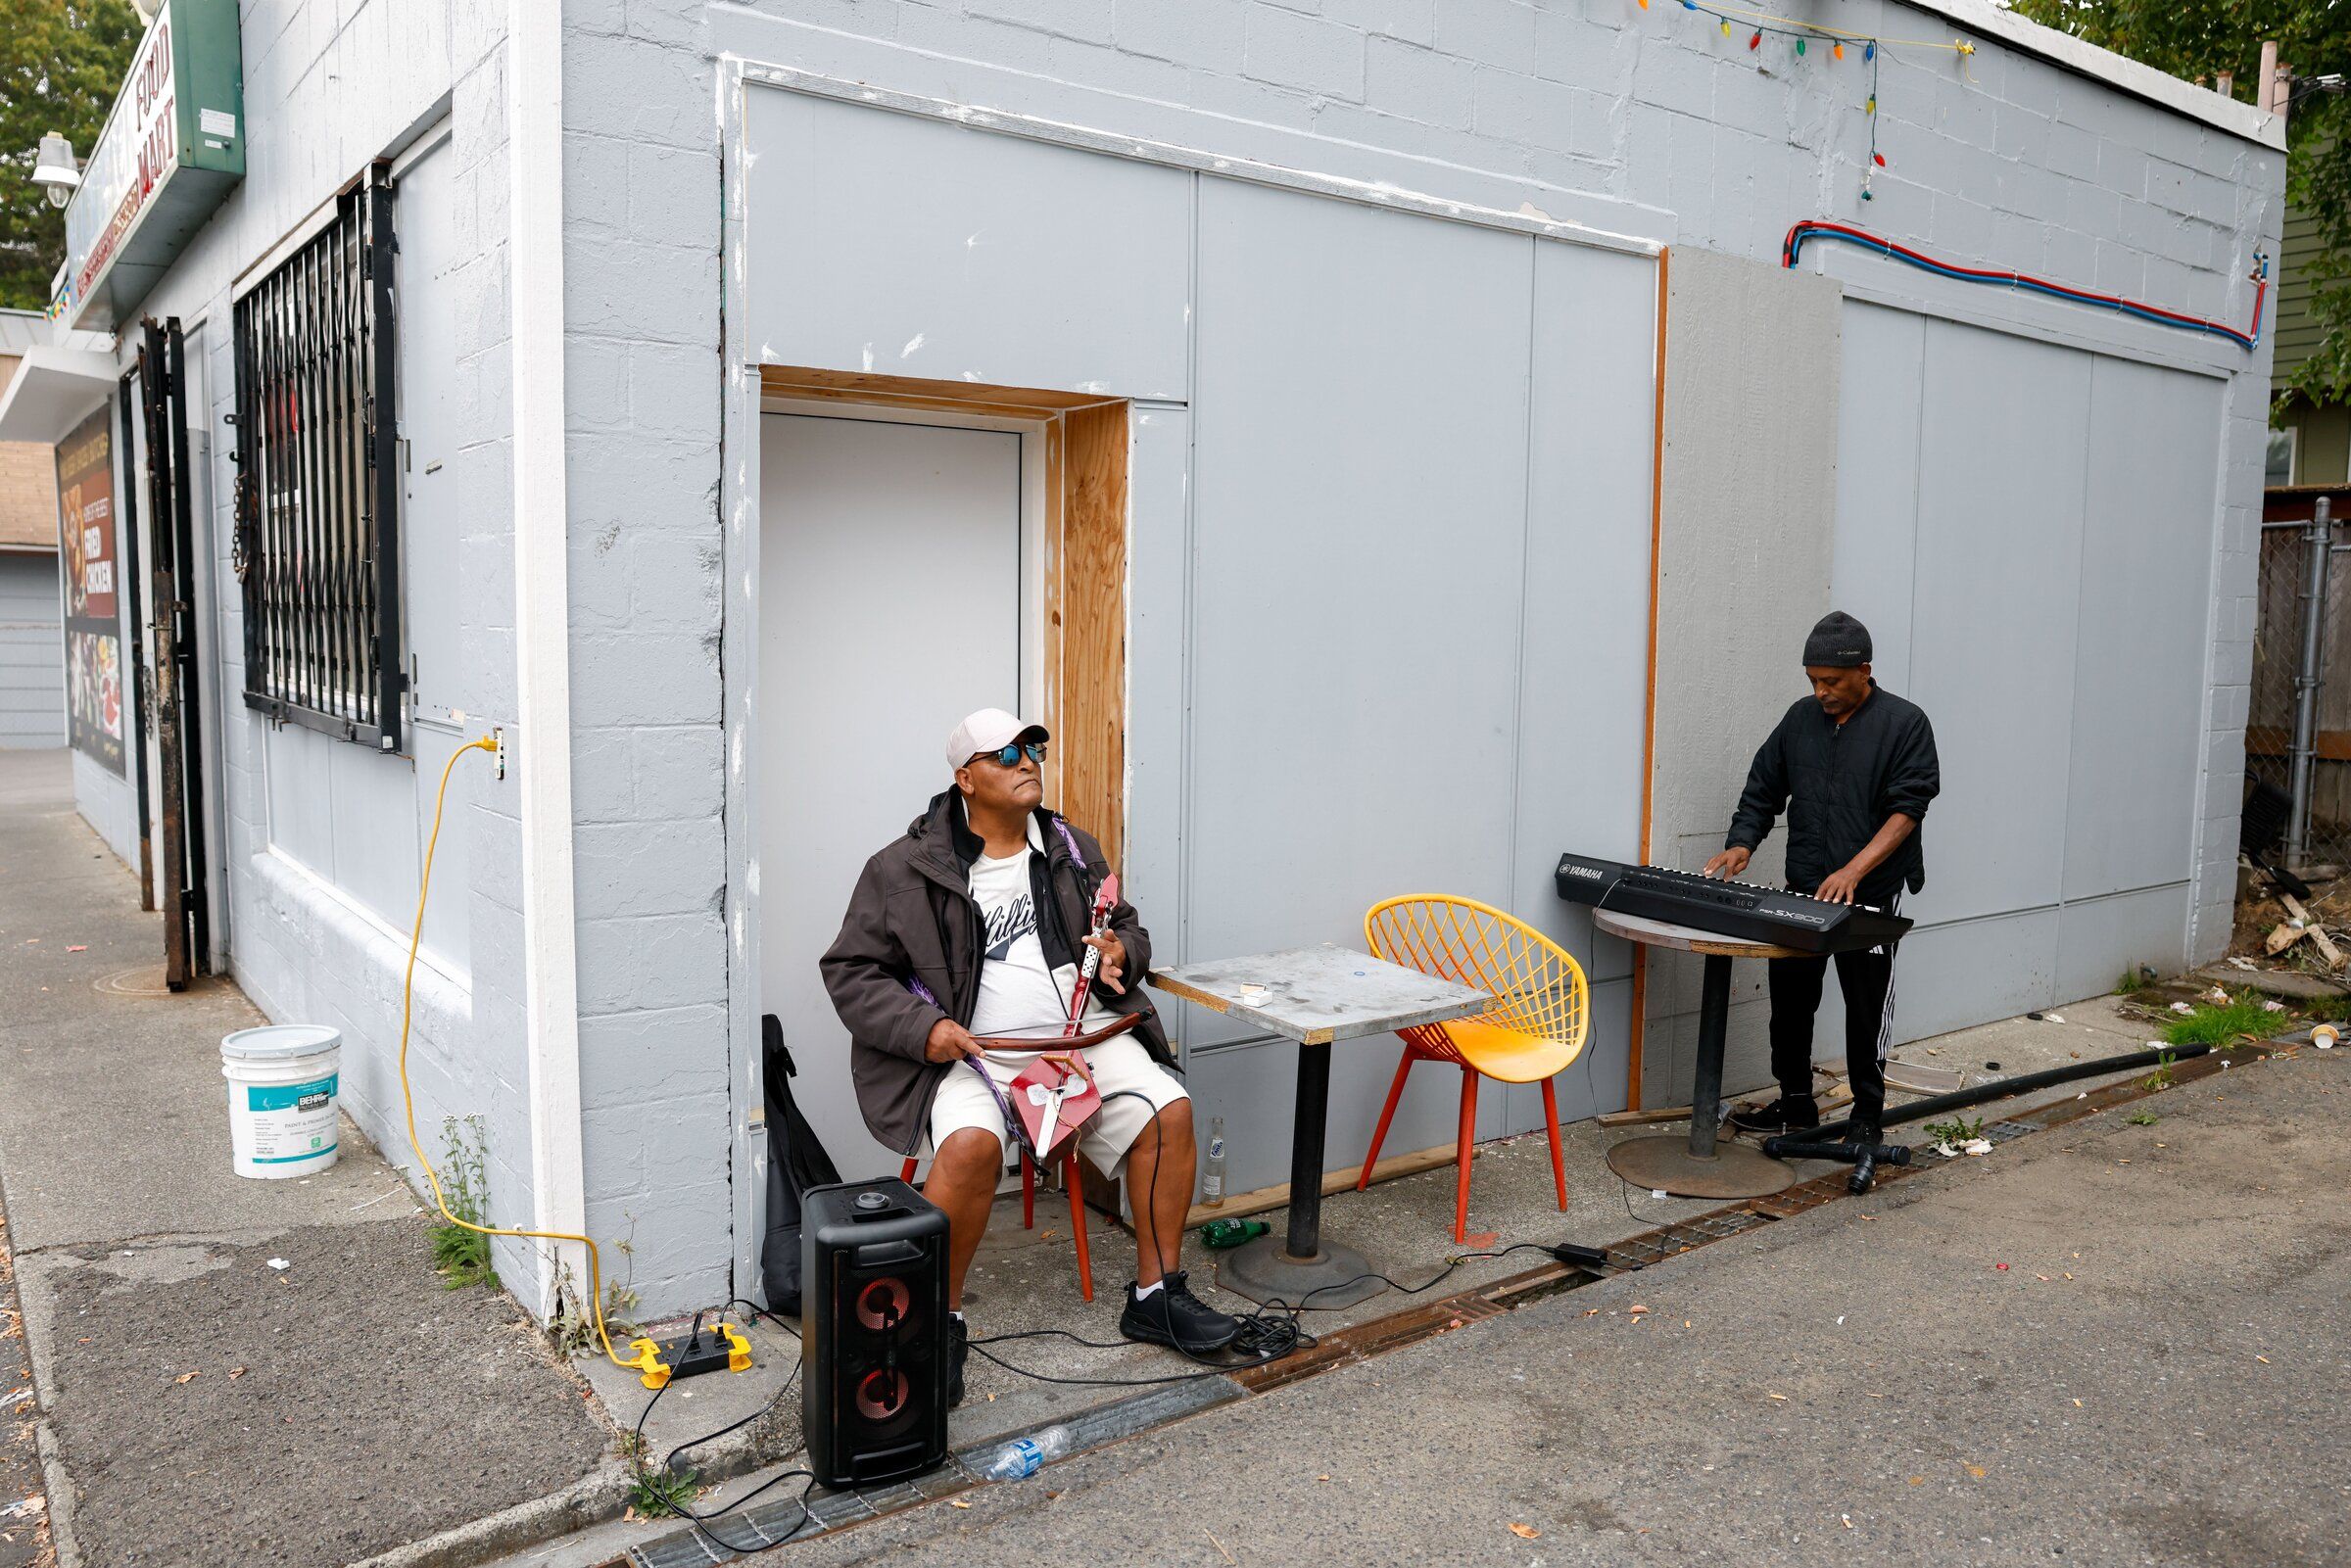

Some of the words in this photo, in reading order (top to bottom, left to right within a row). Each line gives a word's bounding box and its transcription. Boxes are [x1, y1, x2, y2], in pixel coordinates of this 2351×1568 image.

[136, 23, 170, 132] FOOD
[137, 95, 173, 202] MART
[86, 560, 113, 594] CHICKEN
[1569, 865, 1604, 879] YAMAHA
[299, 1093, 326, 1106] BEHR
